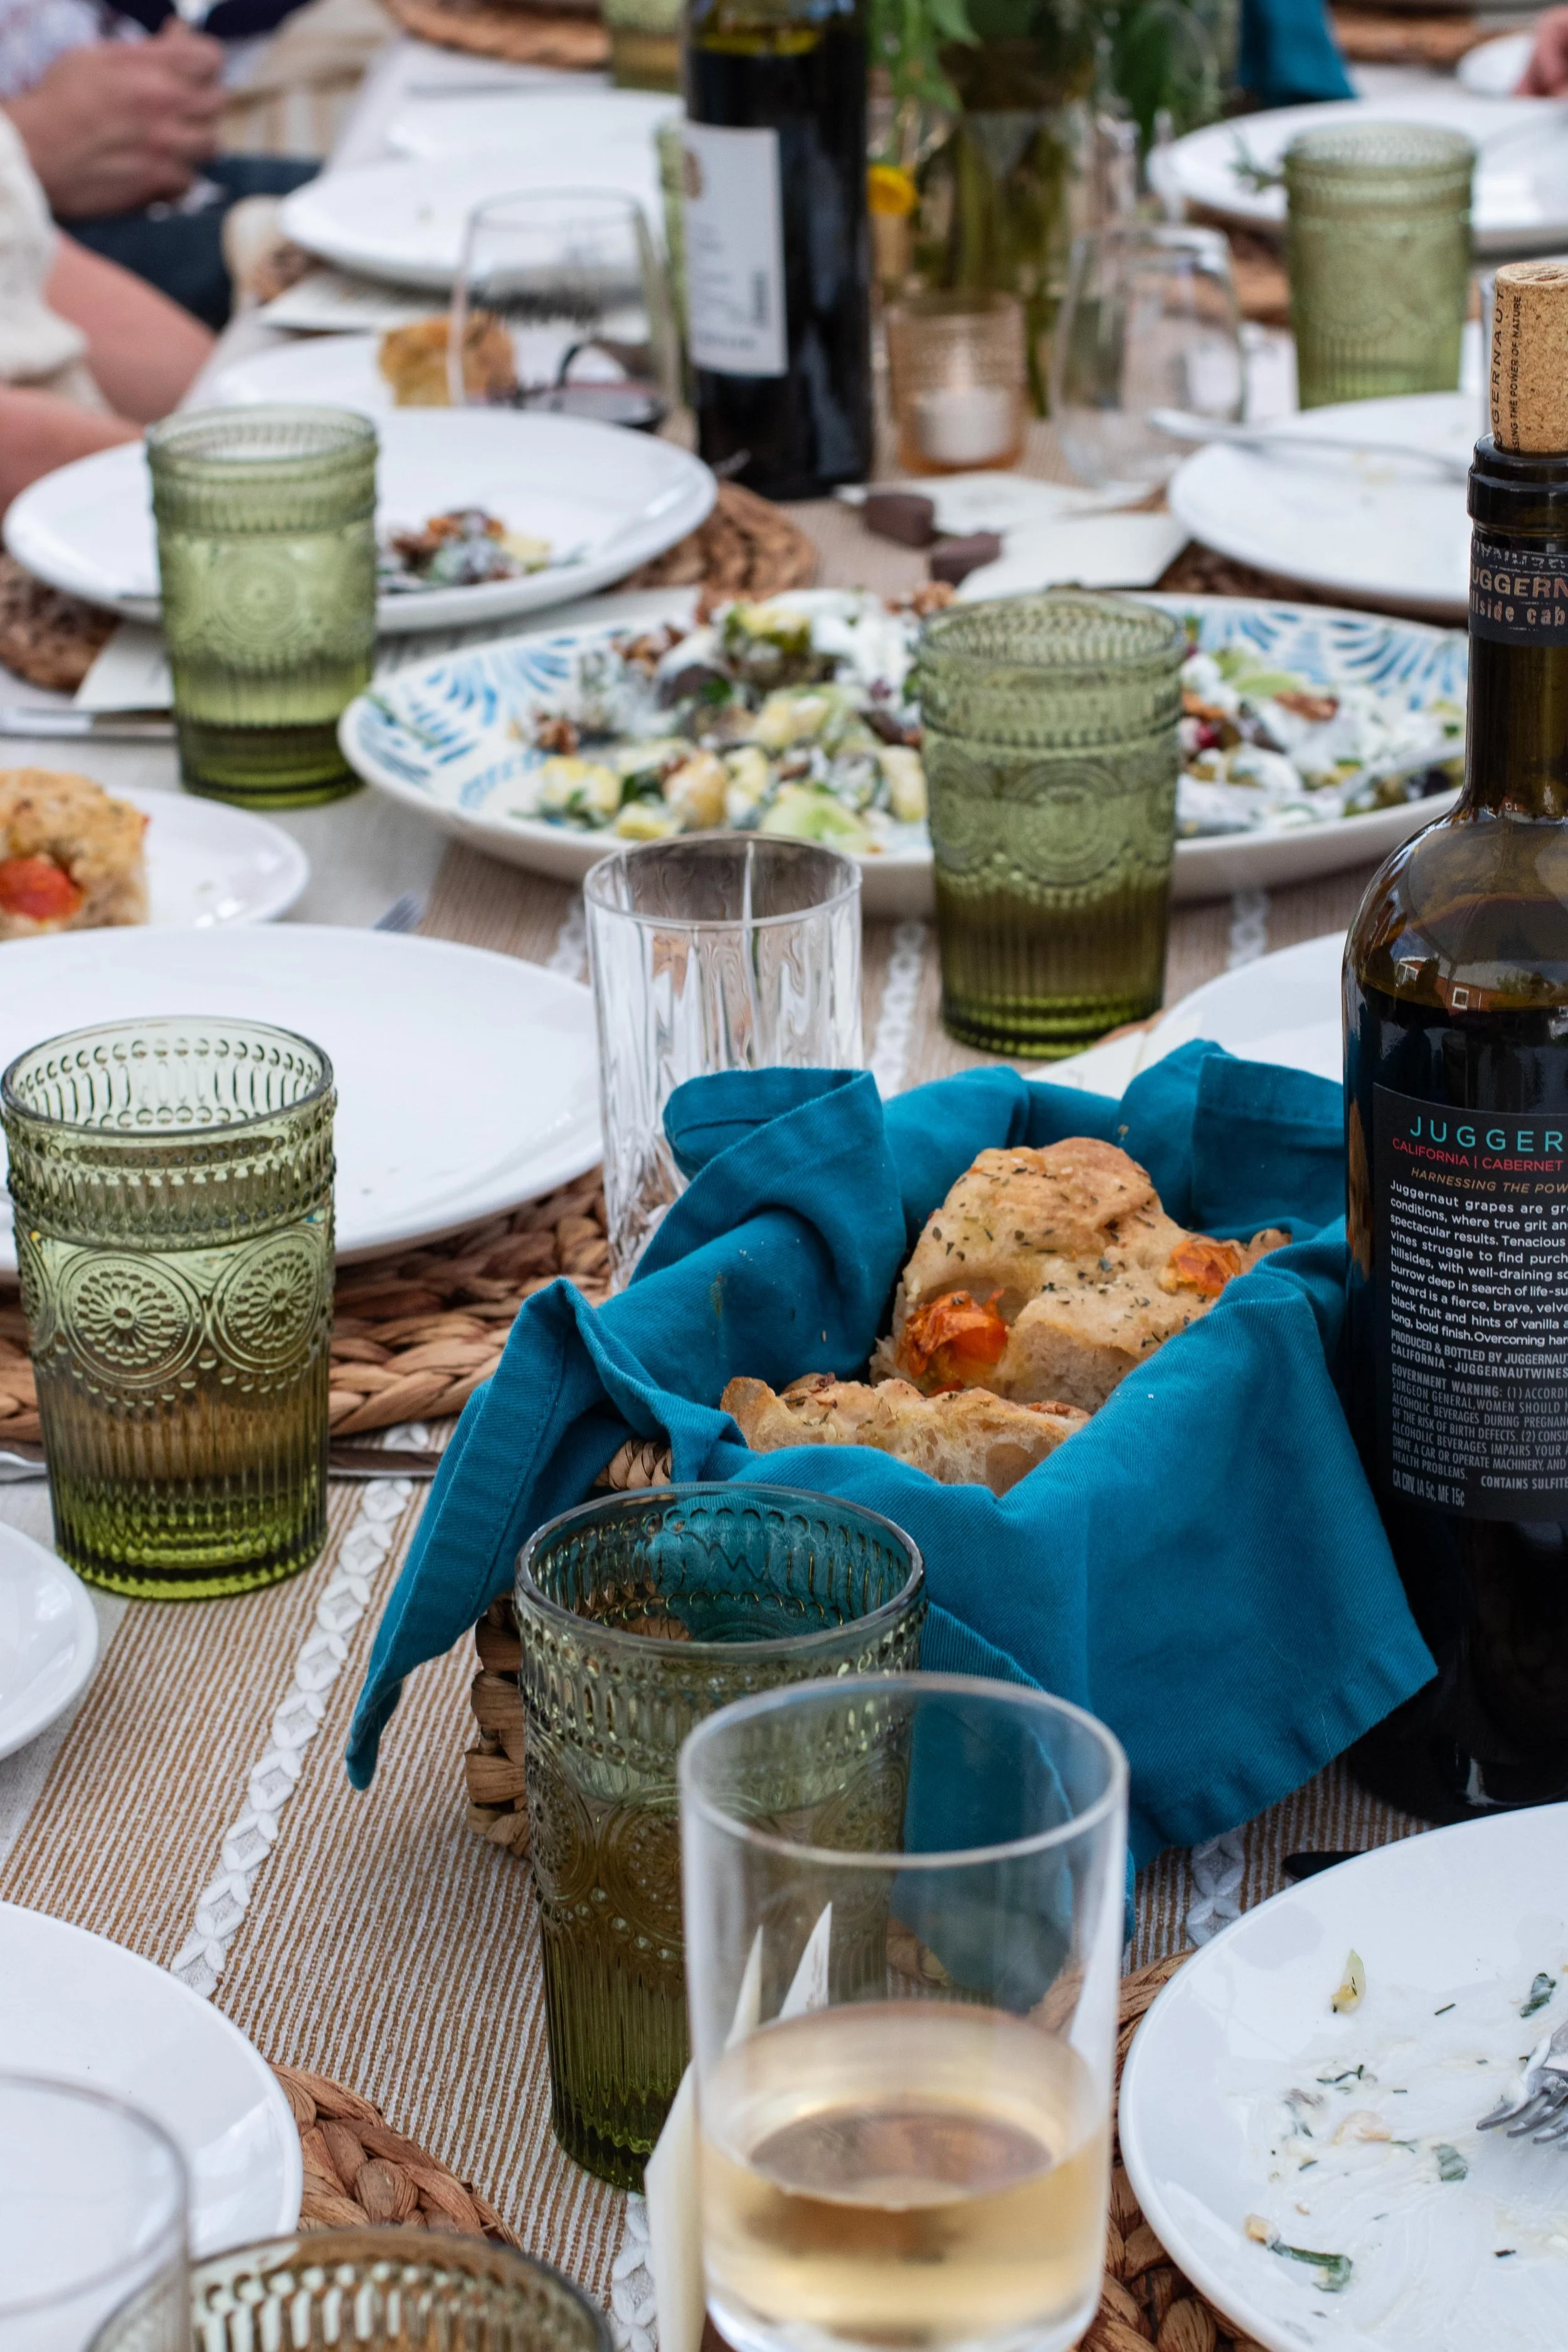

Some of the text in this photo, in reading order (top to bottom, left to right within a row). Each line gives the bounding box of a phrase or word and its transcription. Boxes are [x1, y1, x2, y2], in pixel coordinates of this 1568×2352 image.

[1512, 296, 1521, 338] NATURE
[1512, 342, 1519, 356] OF
[1510, 359, 1518, 397] POWER
[1510, 400, 1518, 418] THE
[1527, 605, 1565, 627] cab
[1410, 1116, 1563, 1152] JUGGER
[1392, 1138, 1469, 1167] CALIFORNIA
[1482, 1157, 1564, 1172] CABERNET
[1391, 1180, 1568, 1216] Juggernaut grapes are gr
[1411, 1167, 1496, 1191] HARNESSING
[1503, 1182, 1530, 1193] THE
[1391, 1197, 1568, 1232] conditions, where true grit an
[1391, 1214, 1565, 1247] spectacular results. Tenacious
[1391, 1230, 1568, 1266] vines struggle to find purch
[1391, 1244, 1434, 1269] hillsides,
[1438, 1261, 1463, 1275] with
[1468, 1266, 1552, 1282] well-draining
[1391, 1260, 1568, 1297] burrow deep in search of life-su
[1391, 1279, 1426, 1299] reward
[1429, 1290, 1438, 1302] is
[1441, 1295, 1448, 1305] a
[1451, 1295, 1490, 1311] fierce,
[1493, 1300, 1533, 1314] brave,
[1391, 1293, 1416, 1313] black
[1419, 1304, 1441, 1320] fruit
[1445, 1311, 1466, 1324] and
[1471, 1315, 1501, 1328] hints
[1505, 1318, 1518, 1329] of
[1521, 1318, 1559, 1330] vanilla
[1391, 1310, 1413, 1328] long,
[1416, 1318, 1439, 1335] bold
[1474, 1331, 1545, 1348] Overcoming
[1549, 1335, 1568, 1345] har
[1391, 1328, 1432, 1352] PRODUCED
[1434, 1342, 1442, 1355] &
[1444, 1345, 1485, 1362] BOTTLED
[1488, 1352, 1502, 1364] BY
[1391, 1343, 1445, 1370] CALIFORNIA
[1454, 1361, 1568, 1379] JUGGERNAUTWINES
[1392, 1362, 1568, 1399] GOVERNMENT WARNING: (1) ACCORDI
[1392, 1377, 1428, 1400] SURGEON
[1476, 1399, 1515, 1412] WOMEN
[1519, 1402, 1560, 1414] SHOULD
[1392, 1392, 1431, 1415] ALCOHOLIC
[1434, 1404, 1480, 1424] BEVERAGES
[1484, 1414, 1520, 1428] DURING
[1392, 1406, 1401, 1419] OF
[1403, 1410, 1416, 1425] THE
[1417, 1414, 1434, 1431] RISK
[1436, 1420, 1447, 1433] OF
[1449, 1423, 1475, 1438] BIRTH
[1522, 1429, 1535, 1443] (2)
[1539, 1430, 1568, 1442] CONSU
[1392, 1421, 1434, 1444] ALCOHOLIC
[1438, 1434, 1486, 1453] BEVERAGES
[1491, 1444, 1531, 1456] IMPAIRS
[1535, 1444, 1561, 1457] YOUR
[1392, 1435, 1566, 1471] DRIVE A CAR OR OPERATE MACHINERY, AND
[1392, 1449, 1468, 1480] HEALTH PROBLEMS.
[1481, 1475, 1568, 1490] CONTAINS SULFITE
[1392, 1468, 1401, 1488] CA
[1417, 1478, 1424, 1497] IA
[1438, 1484, 1449, 1504] ME
